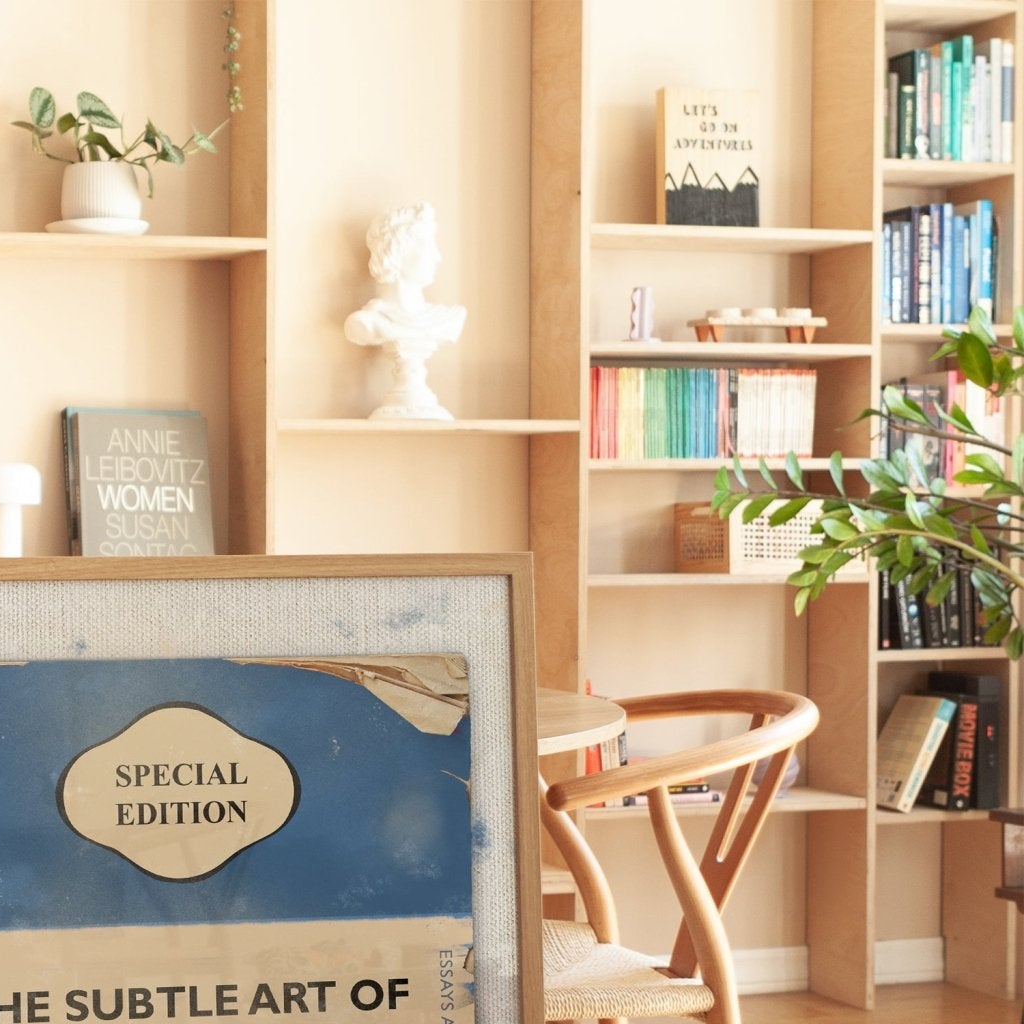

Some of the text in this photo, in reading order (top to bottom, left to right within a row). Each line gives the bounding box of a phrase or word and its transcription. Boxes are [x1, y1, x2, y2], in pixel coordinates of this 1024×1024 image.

[683, 104, 719, 117] LET'S
[700, 121, 739, 133] GO ON
[673, 138, 754, 151] ADVENTURES
[107, 428, 181, 457] ANNIE
[85, 455, 206, 485] LEIBOVITZ
[97, 484, 194, 513] WOMEN
[105, 512, 189, 541] SUSAN
[953, 703, 977, 797] MOVIE BOX
[116, 763, 248, 787] SPECIAL
[115, 801, 247, 825] EDITION
[439, 950, 453, 1011] ESSAYS
[66, 984, 238, 1022] SUBTLE
[248, 981, 336, 1015] ART
[350, 978, 409, 1011] OF
